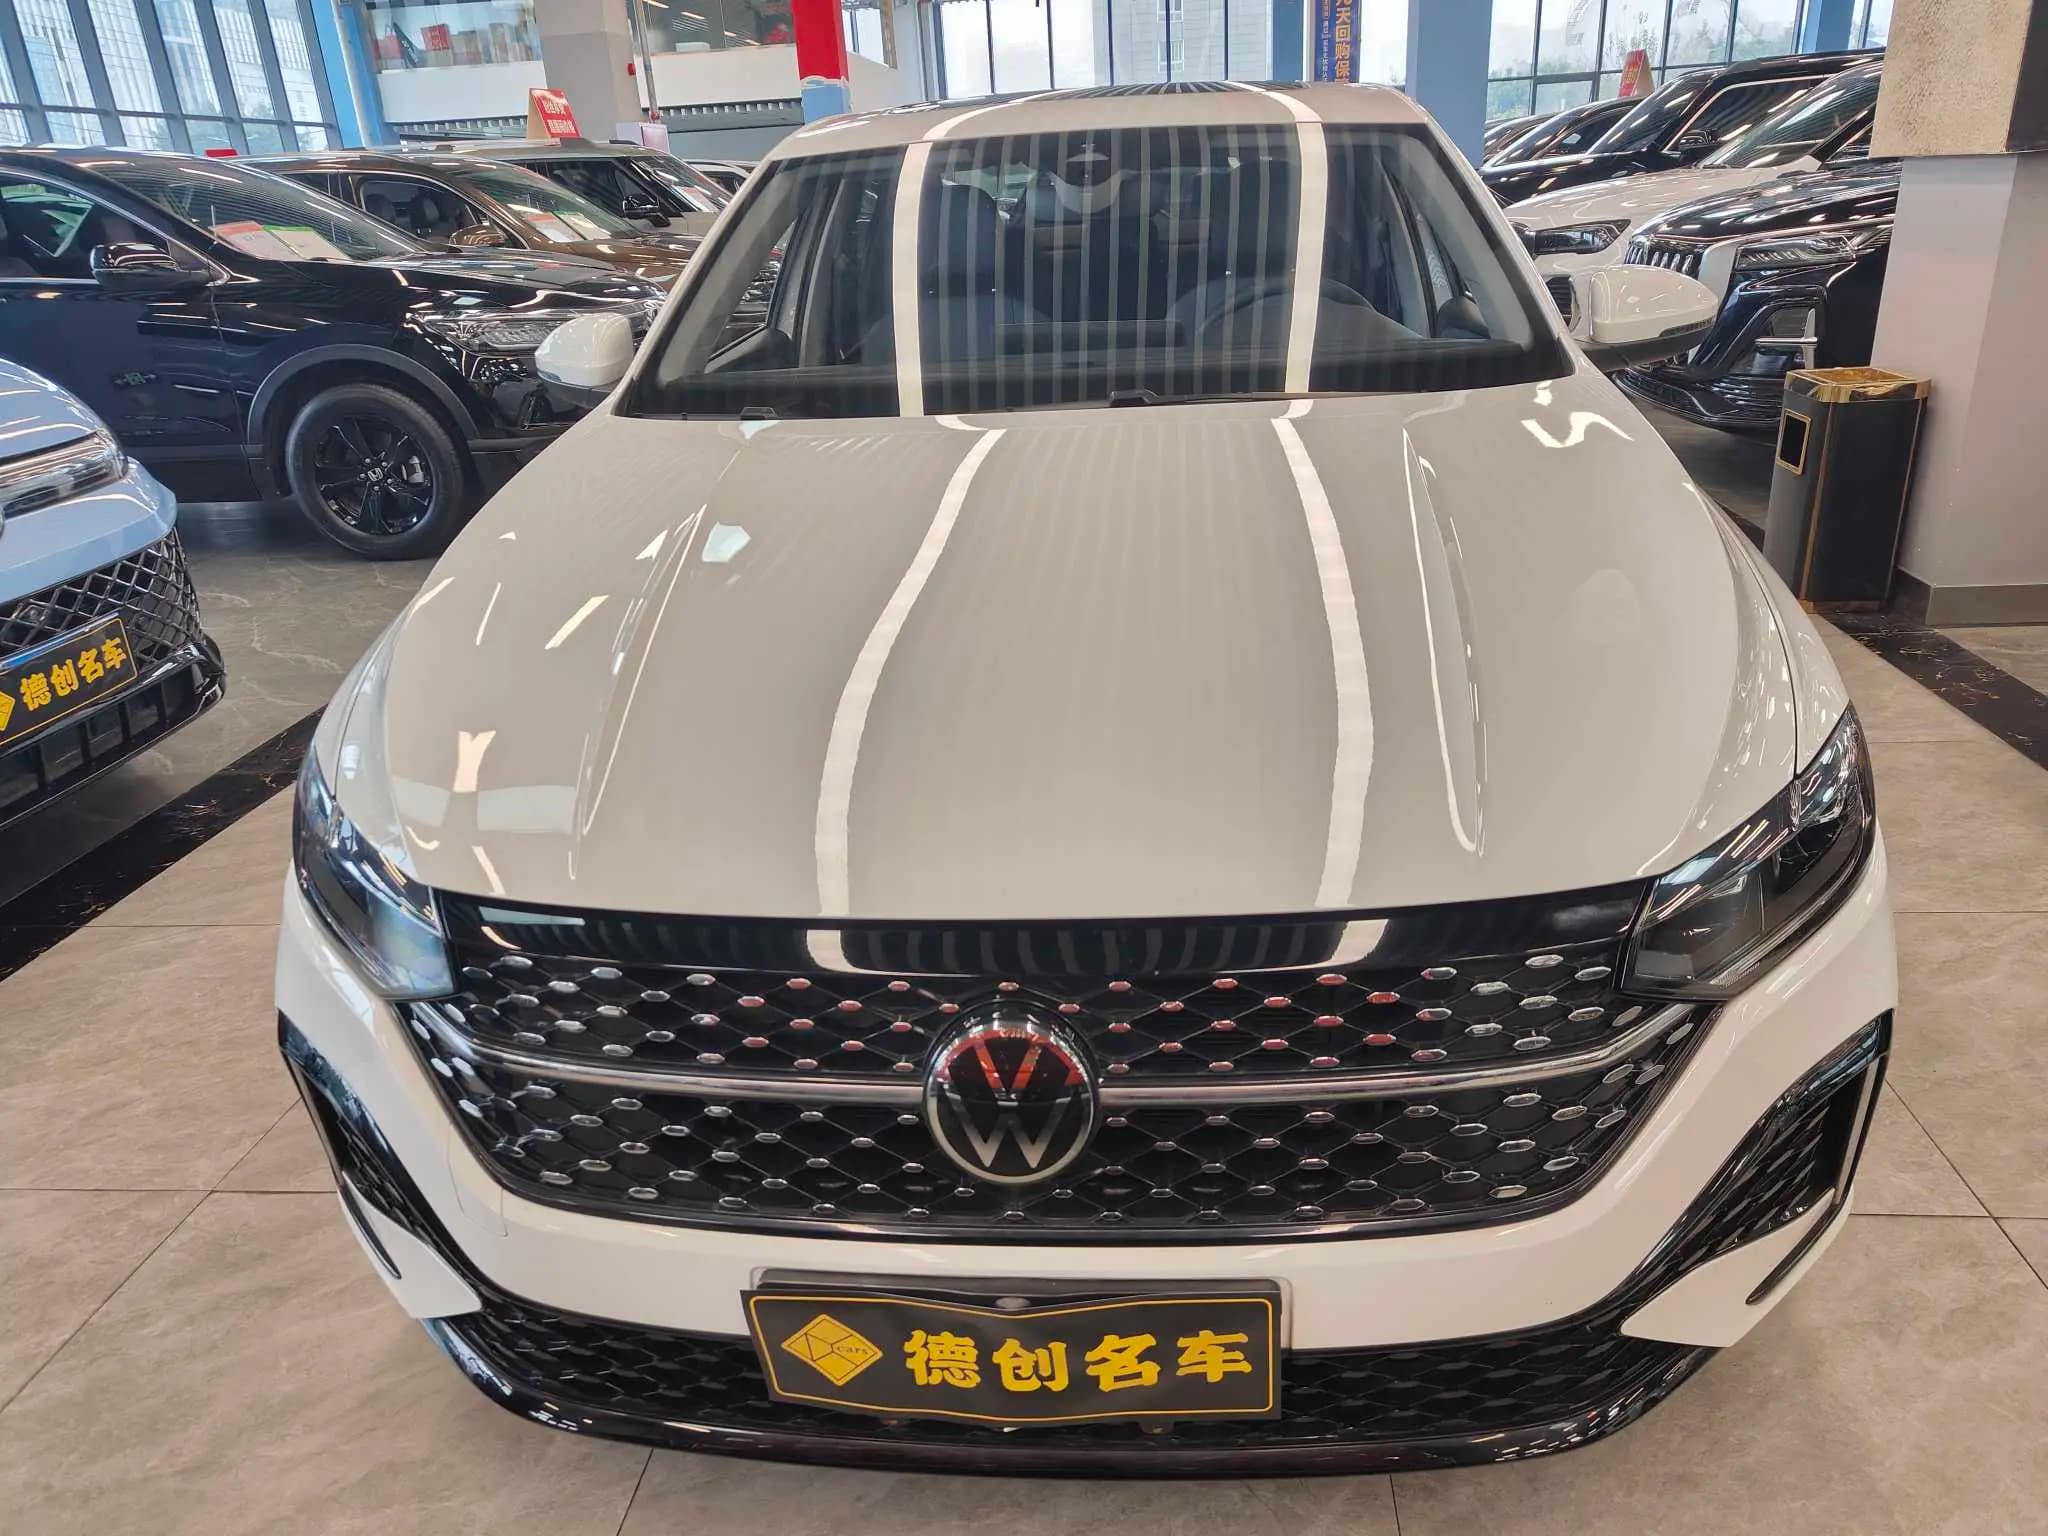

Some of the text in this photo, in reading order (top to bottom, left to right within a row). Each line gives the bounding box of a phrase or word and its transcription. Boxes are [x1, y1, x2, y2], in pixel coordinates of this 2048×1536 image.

[20, 637, 127, 711] 德创名车
[903, 1328, 1253, 1391] 德创名车
